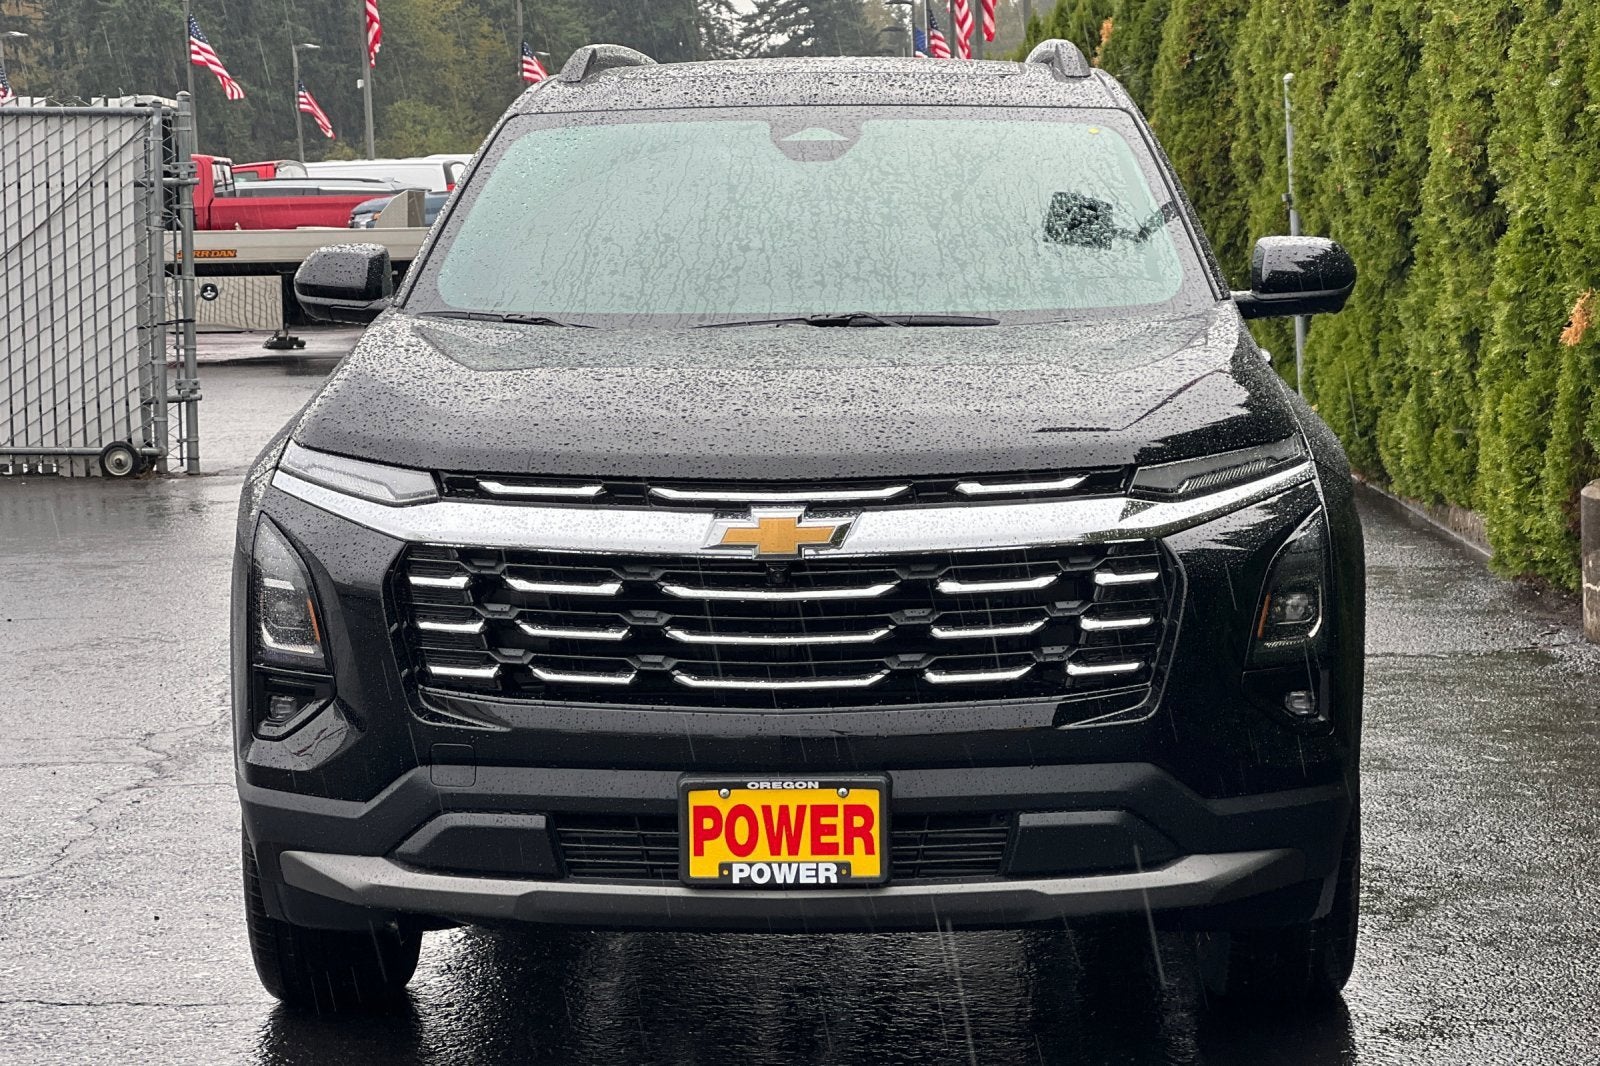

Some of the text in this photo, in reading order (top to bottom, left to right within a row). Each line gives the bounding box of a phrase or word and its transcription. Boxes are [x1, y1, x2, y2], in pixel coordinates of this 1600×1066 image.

[747, 781, 820, 789] OREGON
[693, 804, 875, 857] POWER
[732, 863, 838, 884] POWER
